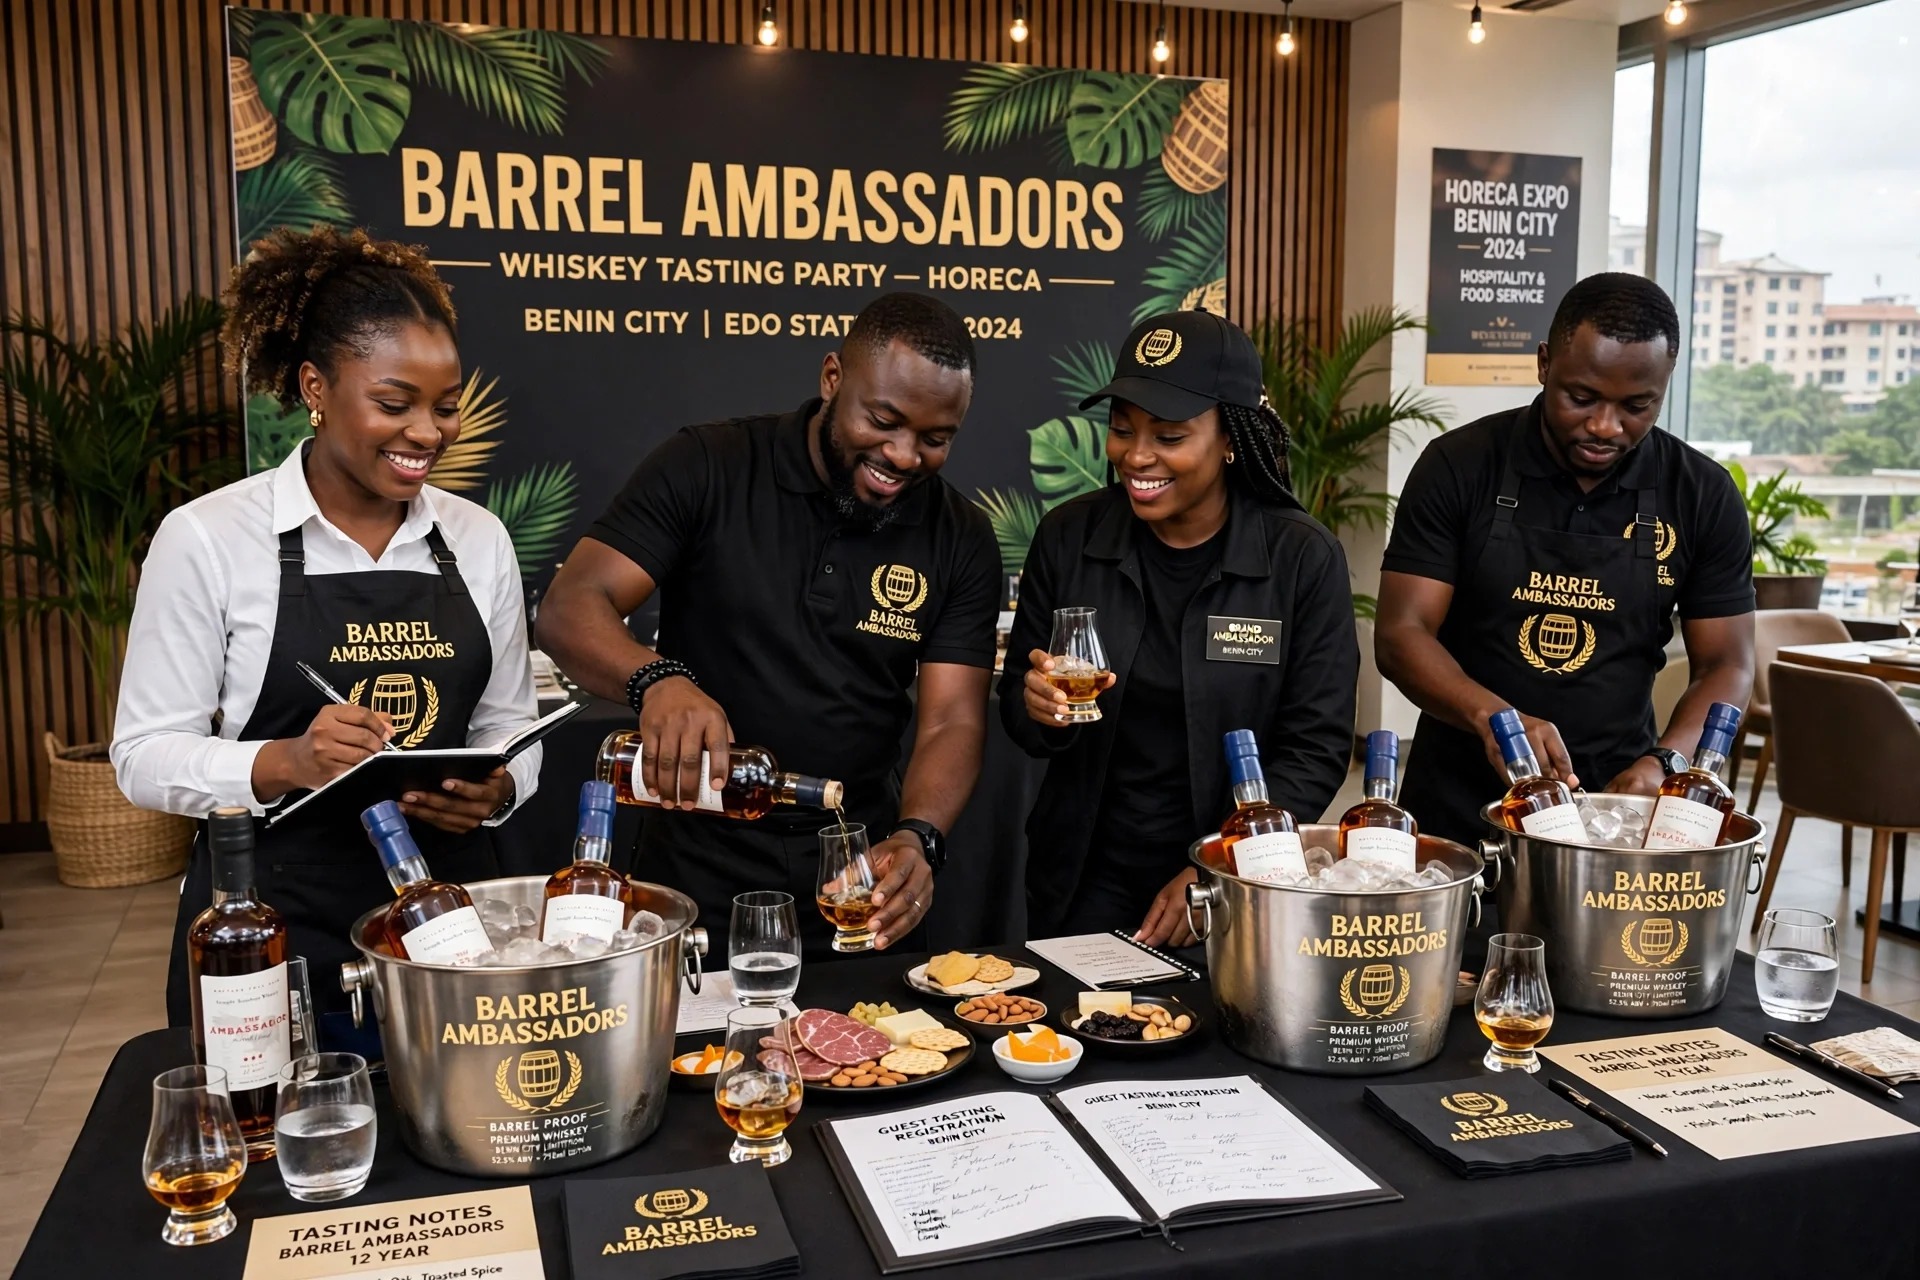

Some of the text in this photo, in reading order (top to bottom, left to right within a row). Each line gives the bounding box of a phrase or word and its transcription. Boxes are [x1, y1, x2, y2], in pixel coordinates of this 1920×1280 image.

[402, 148, 1124, 251] BARREL AMBASSADORS
[1445, 179, 1569, 209] HORECA EXPO
[1454, 208, 1558, 236] BENIN CITY
[1483, 237, 1526, 260] 2024
[500, 252, 647, 281] WHISKEY
[656, 257, 784, 285] TASTING
[795, 261, 887, 287] PARTY
[928, 266, 1042, 291] HORECA
[1460, 269, 1546, 286] HOSPITALITY &
[1460, 288, 1545, 304] FOOD SERVICE
[525, 308, 615, 333] BENIN
[625, 311, 689, 334] CITY
[725, 312, 781, 336] EDO
[790, 314, 859, 337] STAT
[963, 317, 1022, 339] 2024
[1529, 571, 1603, 596] BARREL
[1512, 587, 1616, 611] AMBASSADORS
[855, 620, 922, 642] AMBASSADORS
[869, 609, 917, 631] BARREL
[346, 621, 438, 643] BARREL
[329, 643, 455, 662] AMBASSADORS
[1246, 648, 1264, 656] CITY
[1614, 871, 1706, 892] BARREL
[1582, 888, 1726, 912] AMBASSADORS
[1331, 911, 1426, 937] BARREL
[1297, 929, 1447, 958] AMBASSADORS
[1611, 971, 1687, 981] BARREL PROOF
[475, 986, 595, 1021] BARREL
[441, 1004, 628, 1045] AMBASSADORS
[1330, 1021, 1410, 1035] BARREL PROOF
[1574, 1040, 1720, 1064] TASTING NOTES
[1589, 1049, 1748, 1074] BARREL AMBASSADORS
[1653, 1064, 1716, 1078] 12 YEAR
[1084, 1094, 1117, 1105] GUEST
[1120, 1090, 1166, 1100] TASTING
[489, 1112, 587, 1132] BARREL PROOF
[878, 1104, 996, 1135] GUEST TASTING
[1450, 1120, 1574, 1142] AMBASSADORS
[1455, 1112, 1547, 1132] BARREL
[490, 1125, 589, 1144] PREMIUM WHISKEY
[963, 1127, 987, 1139] CITY
[289, 1205, 493, 1242] TASTING NOTES
[625, 1216, 732, 1240] BARREL
[279, 1219, 505, 1260] BARREL AMBASSADORS
[602, 1225, 758, 1255] AMBASSADORS
[350, 1245, 430, 1266] 12 YEAR
[471, 1265, 503, 1279] Spice
